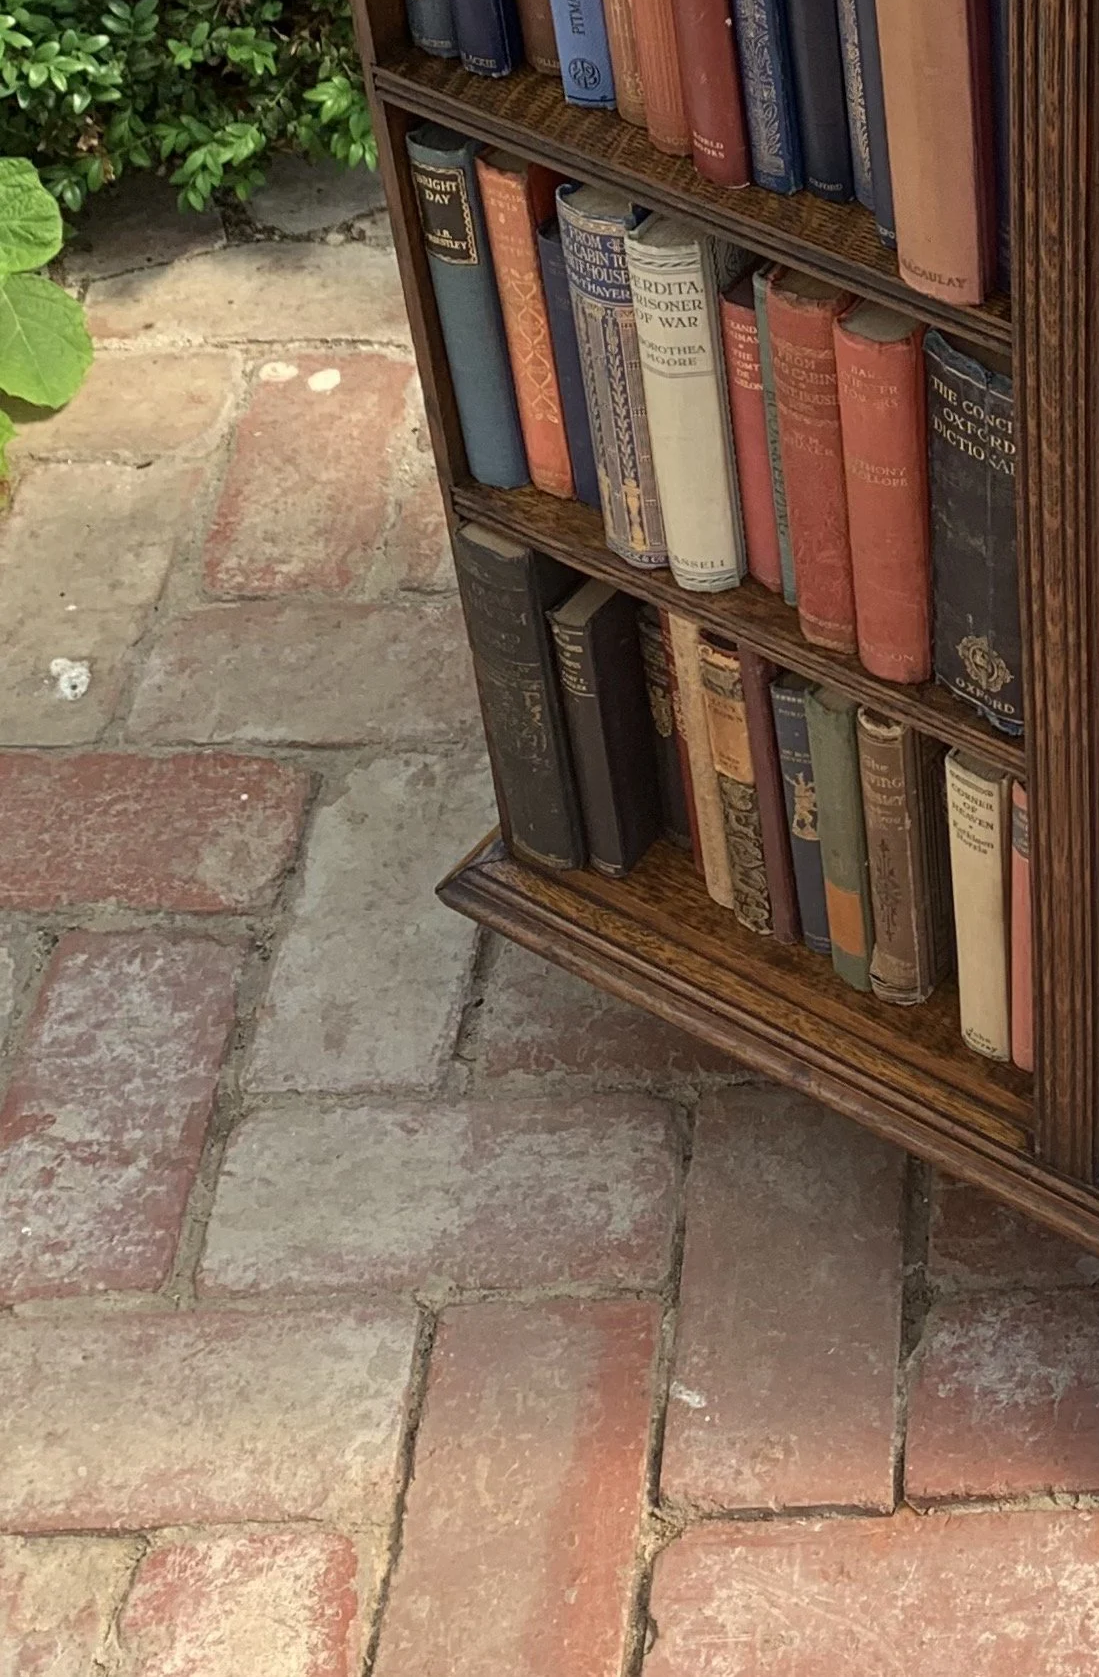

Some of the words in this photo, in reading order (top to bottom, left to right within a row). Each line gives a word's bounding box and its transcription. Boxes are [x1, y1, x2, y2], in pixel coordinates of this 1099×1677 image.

[424, 188, 451, 205] DAY
[568, 224, 602, 250] FROM
[573, 242, 609, 267] CABIN
[610, 253, 628, 269] TO
[636, 307, 653, 324] OF
[658, 315, 699, 329] WAR
[647, 352, 697, 367] MOORE
[731, 348, 753, 362] THE
[931, 374, 958, 406] THE
[962, 399, 1013, 434] CONCI
[943, 407, 1016, 456] OXFORD
[955, 676, 1015, 715] OXFORD
[951, 783, 994, 812] CORNER
[963, 801, 977, 813] OF
[952, 801, 994, 831] HEAVEN
